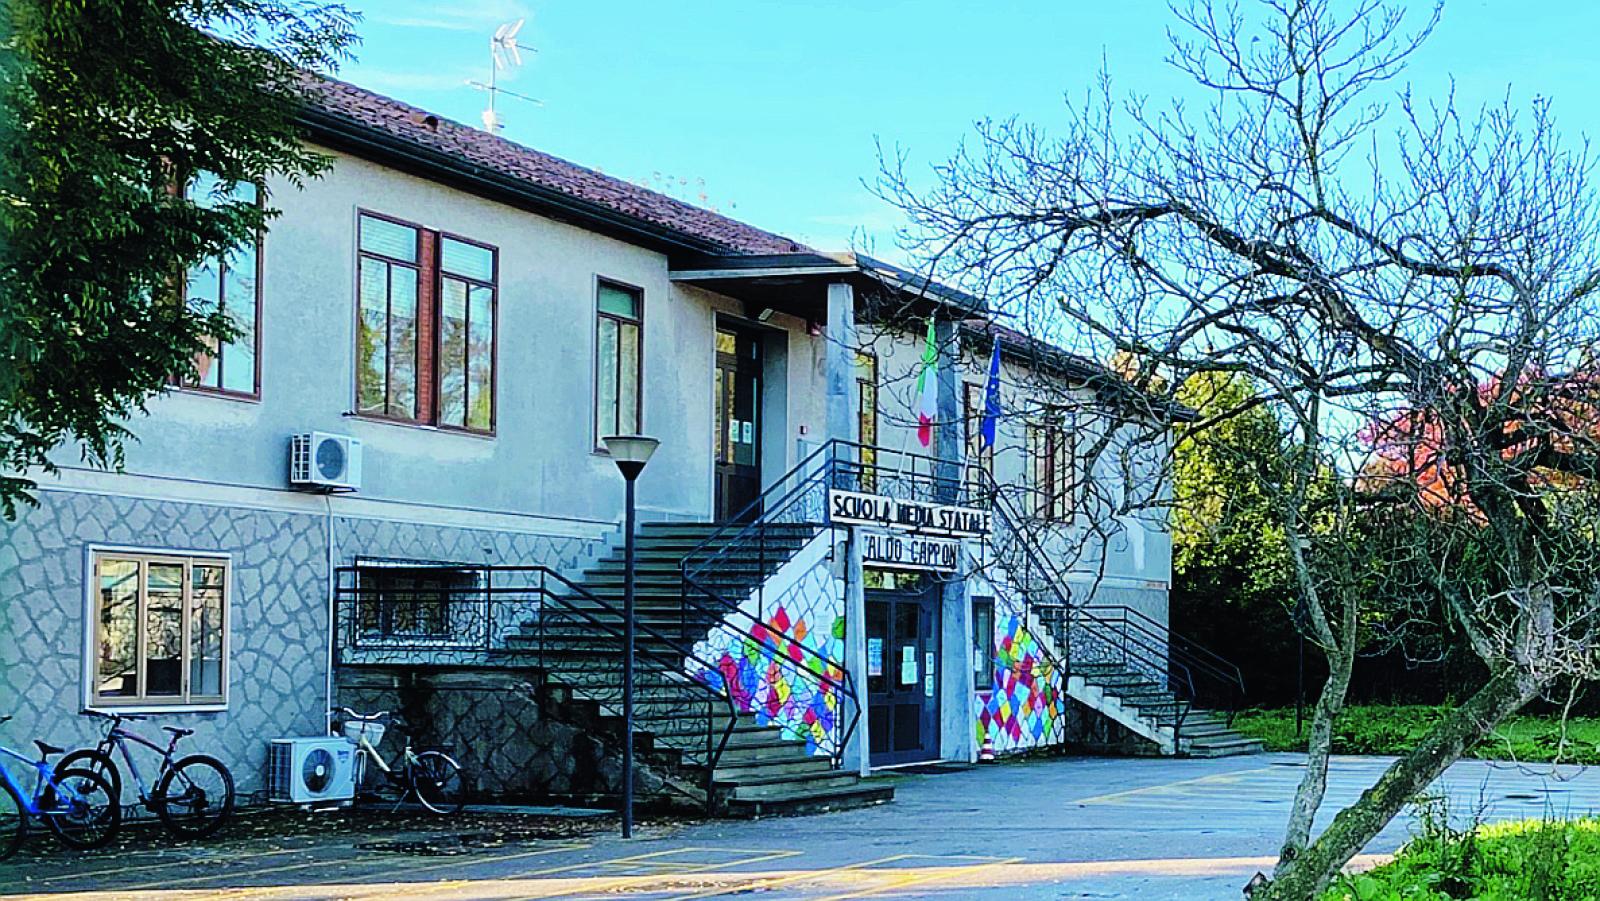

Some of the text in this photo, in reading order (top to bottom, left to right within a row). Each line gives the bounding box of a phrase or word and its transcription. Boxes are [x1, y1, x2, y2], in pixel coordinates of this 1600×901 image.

[833, 494, 991, 533] SCUOLA MEDIA STATALE
